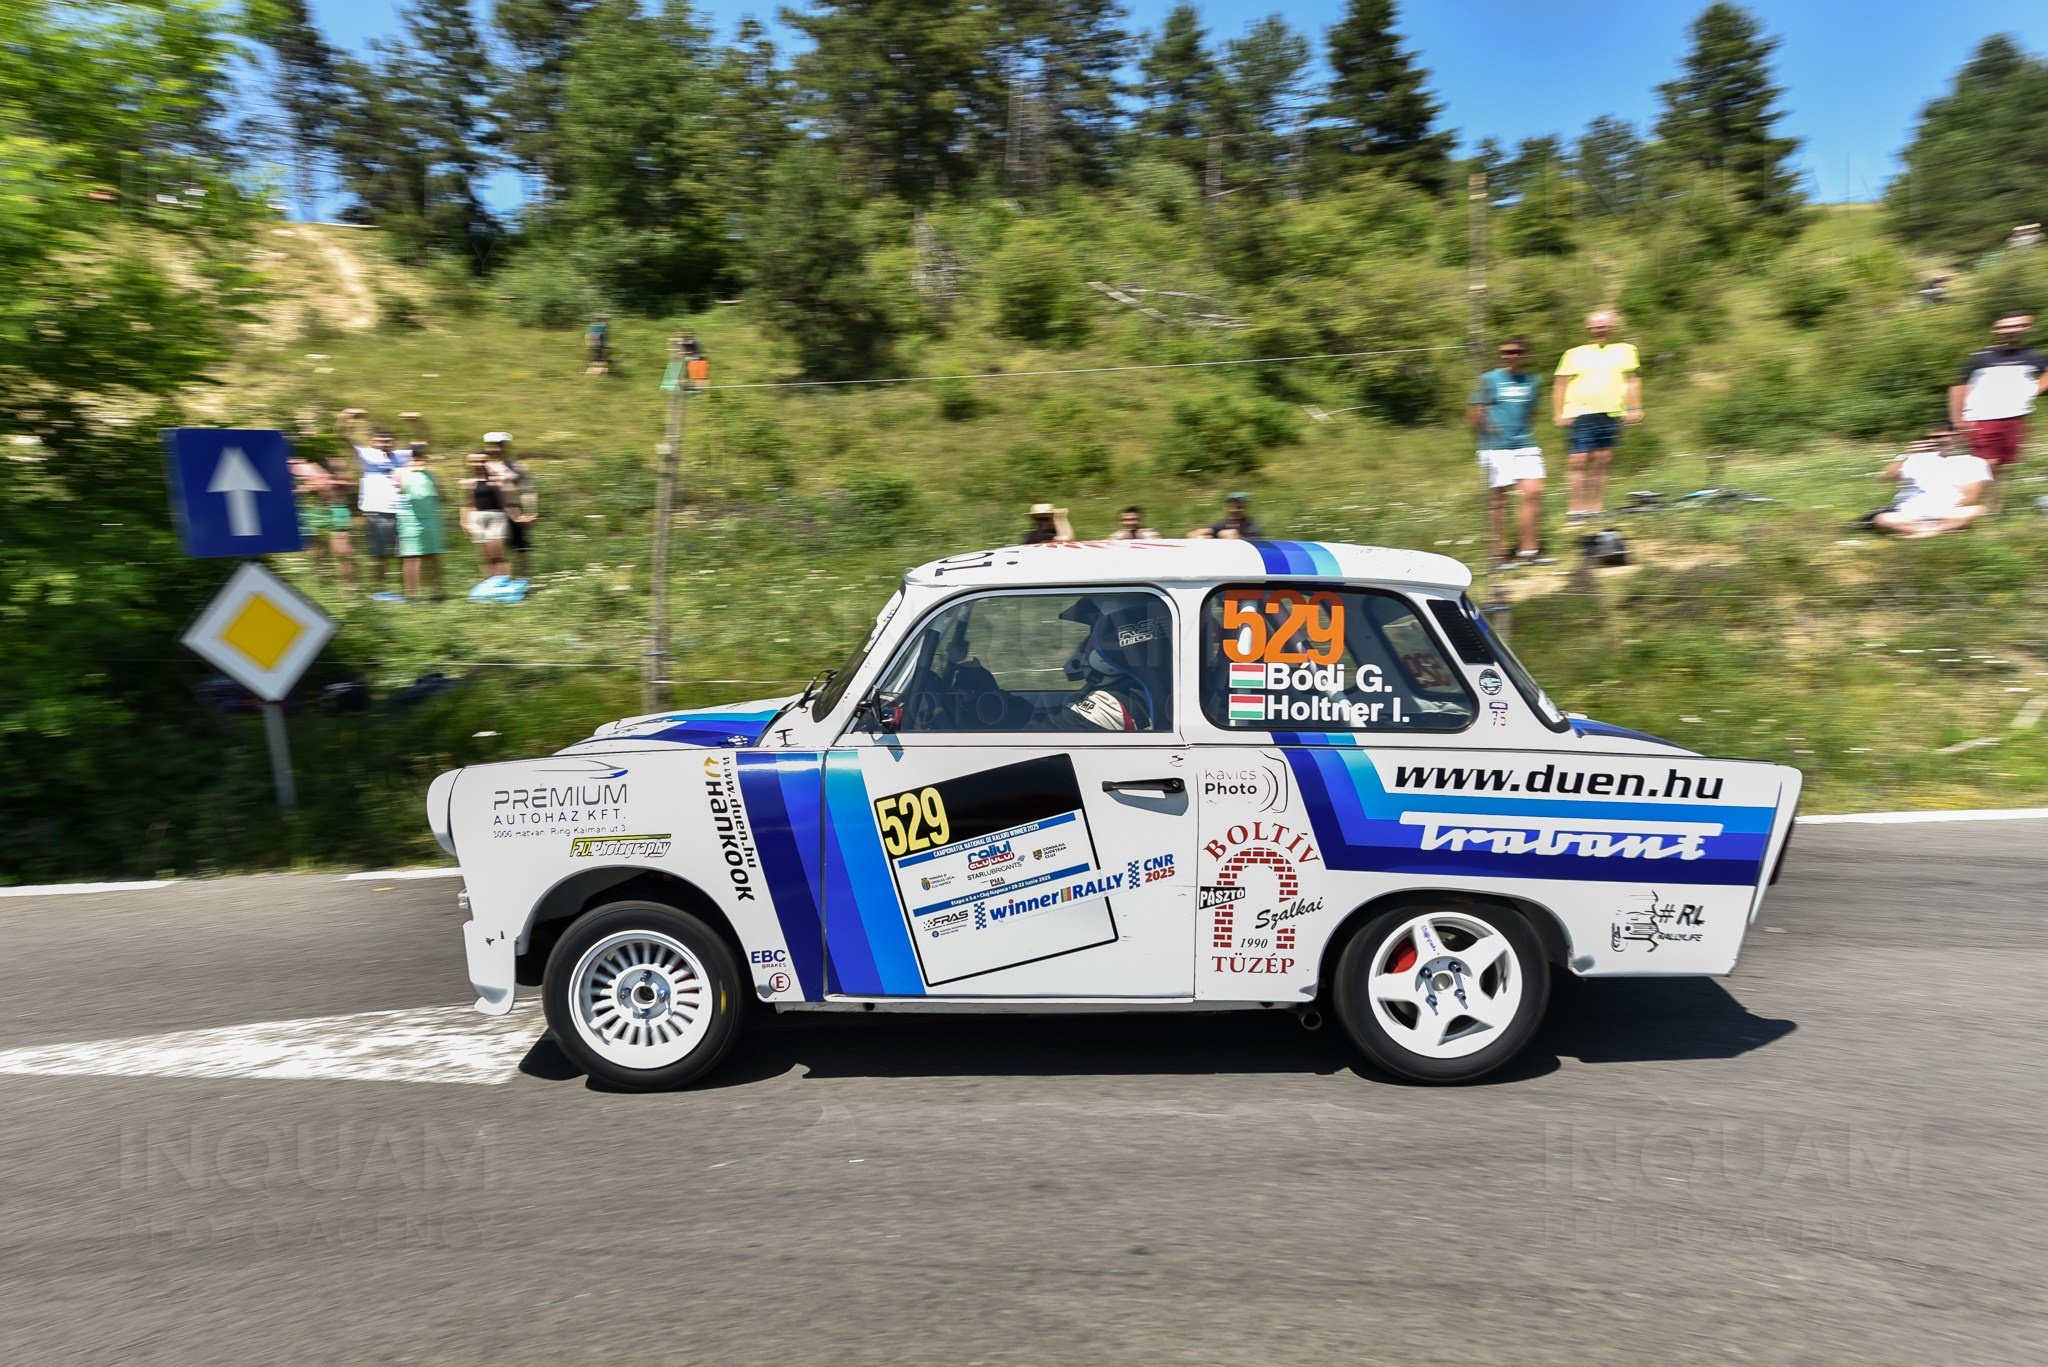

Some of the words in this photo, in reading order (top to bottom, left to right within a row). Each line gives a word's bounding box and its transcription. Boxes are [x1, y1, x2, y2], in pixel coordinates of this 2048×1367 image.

[1222, 589, 1345, 665] 529
[1266, 664, 1345, 692] Bódi
[1355, 668, 1393, 693] G.
[1266, 695, 1384, 722] Holtner
[1393, 697, 1410, 723] I.
[1205, 783, 1257, 795] Photo
[1395, 764, 1724, 800] www.duen.hu
[587, 809, 626, 821] KFT.
[876, 786, 950, 856] 529
[1203, 822, 1320, 864] BOLTÍV
[1400, 810, 1724, 861] Trabant
[1144, 853, 1175, 871] CNR
[1144, 866, 1176, 883] 2025
[990, 891, 1060, 921] winner
[1072, 873, 1124, 900] RALLY
[1255, 897, 1324, 930] Szalkai
[1659, 903, 1706, 926] #RL
[751, 950, 786, 963] EBC
[1240, 938, 1268, 948] 1990
[1211, 952, 1295, 974] TÜZÉP
